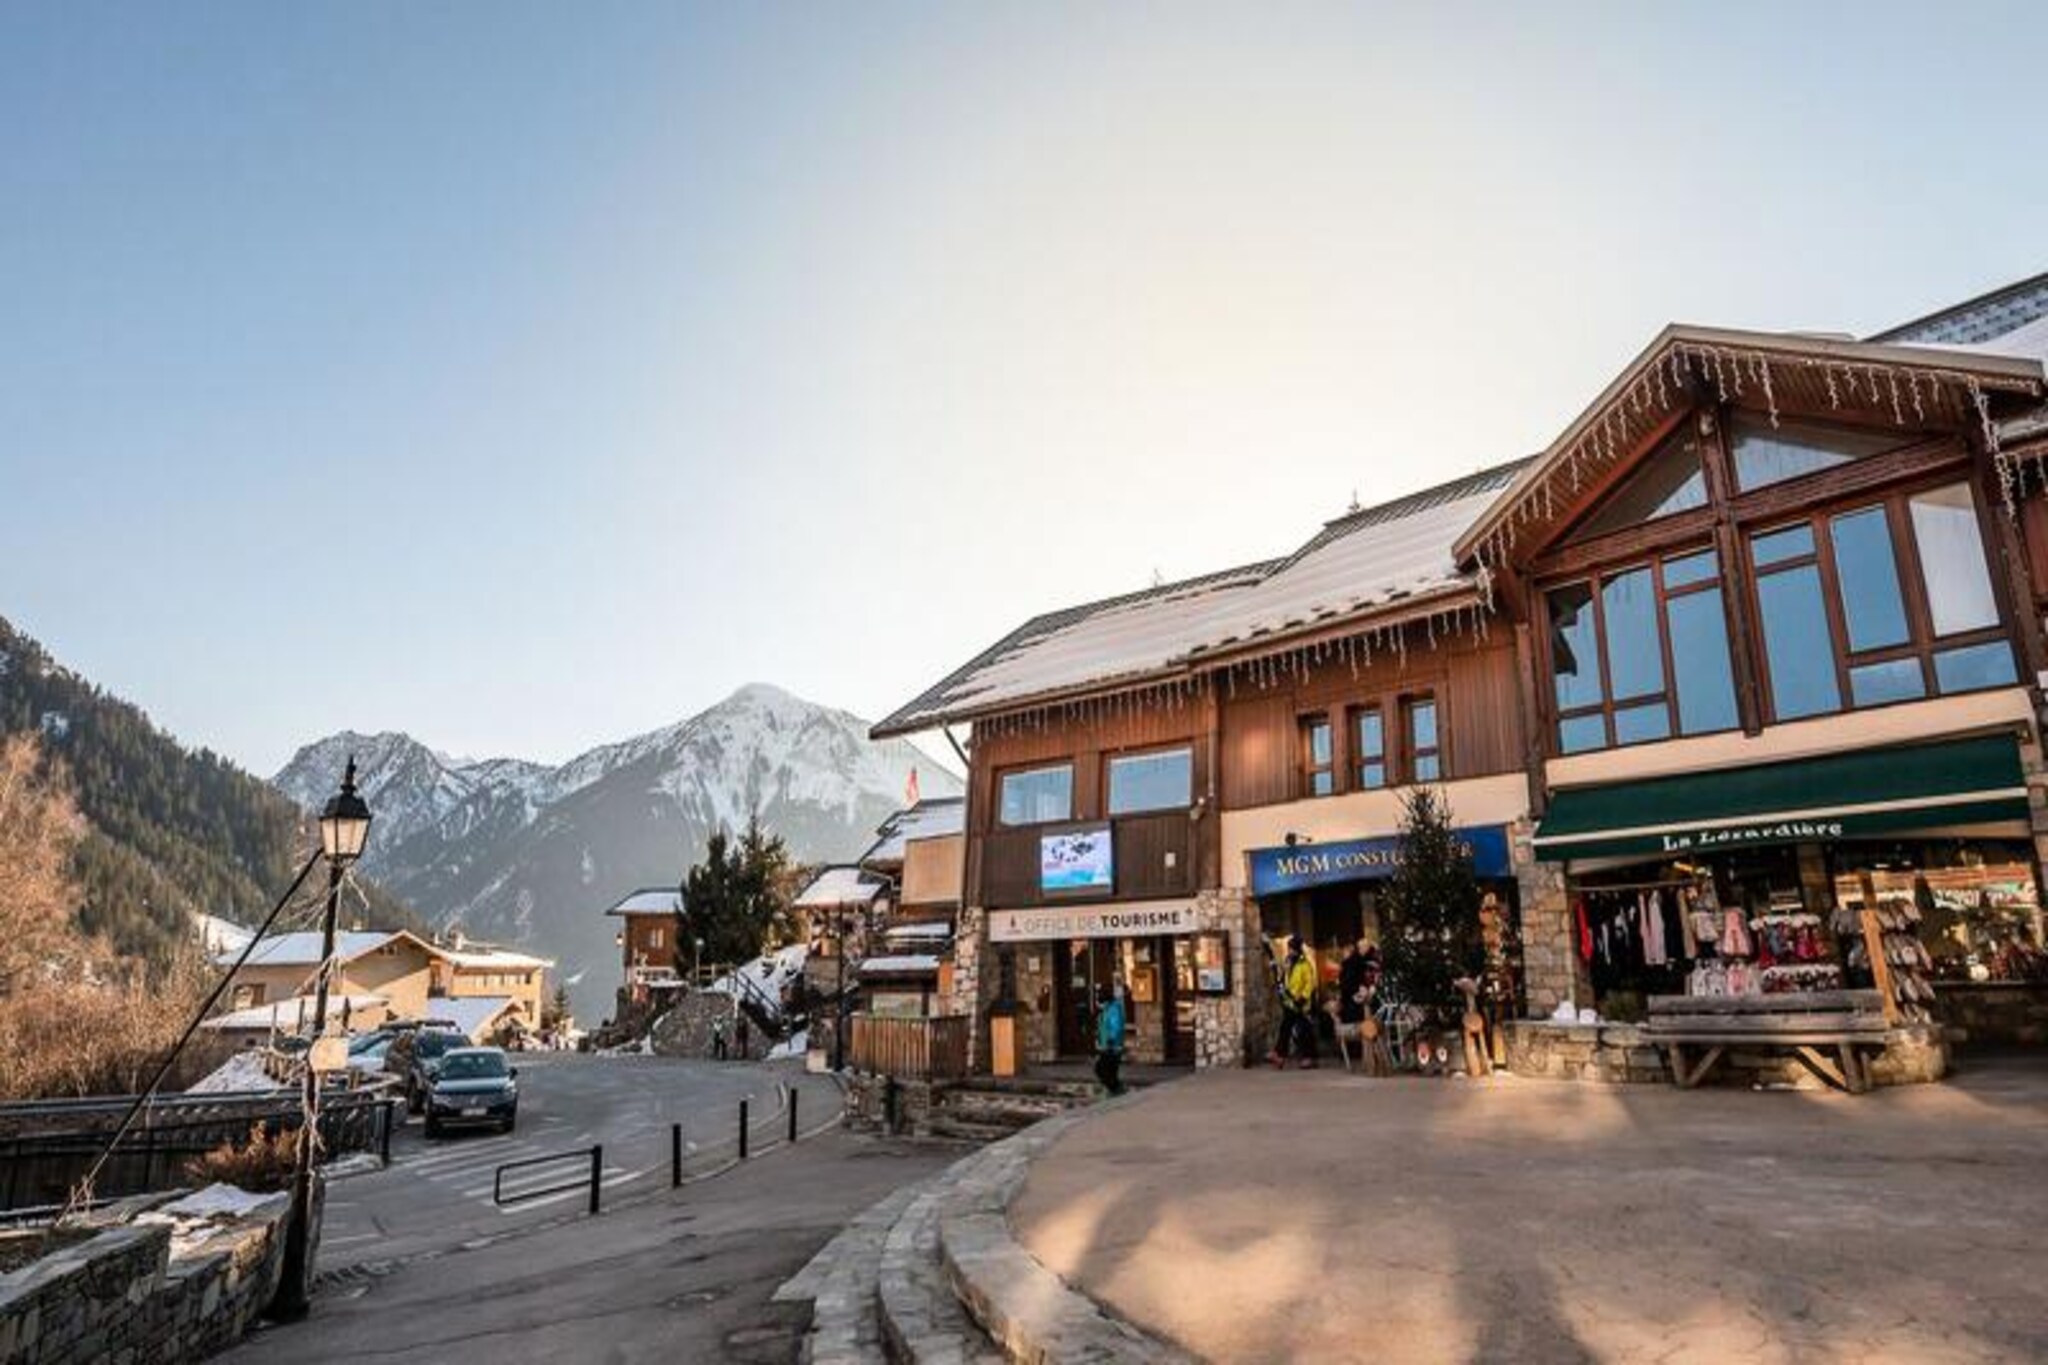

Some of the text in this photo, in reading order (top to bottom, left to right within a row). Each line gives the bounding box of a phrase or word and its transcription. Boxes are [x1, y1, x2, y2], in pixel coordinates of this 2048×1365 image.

[1663, 835, 1691, 851] La
[1276, 854, 1330, 876] MGM
[1024, 911, 1181, 933] OFFICE DE TOURISME
